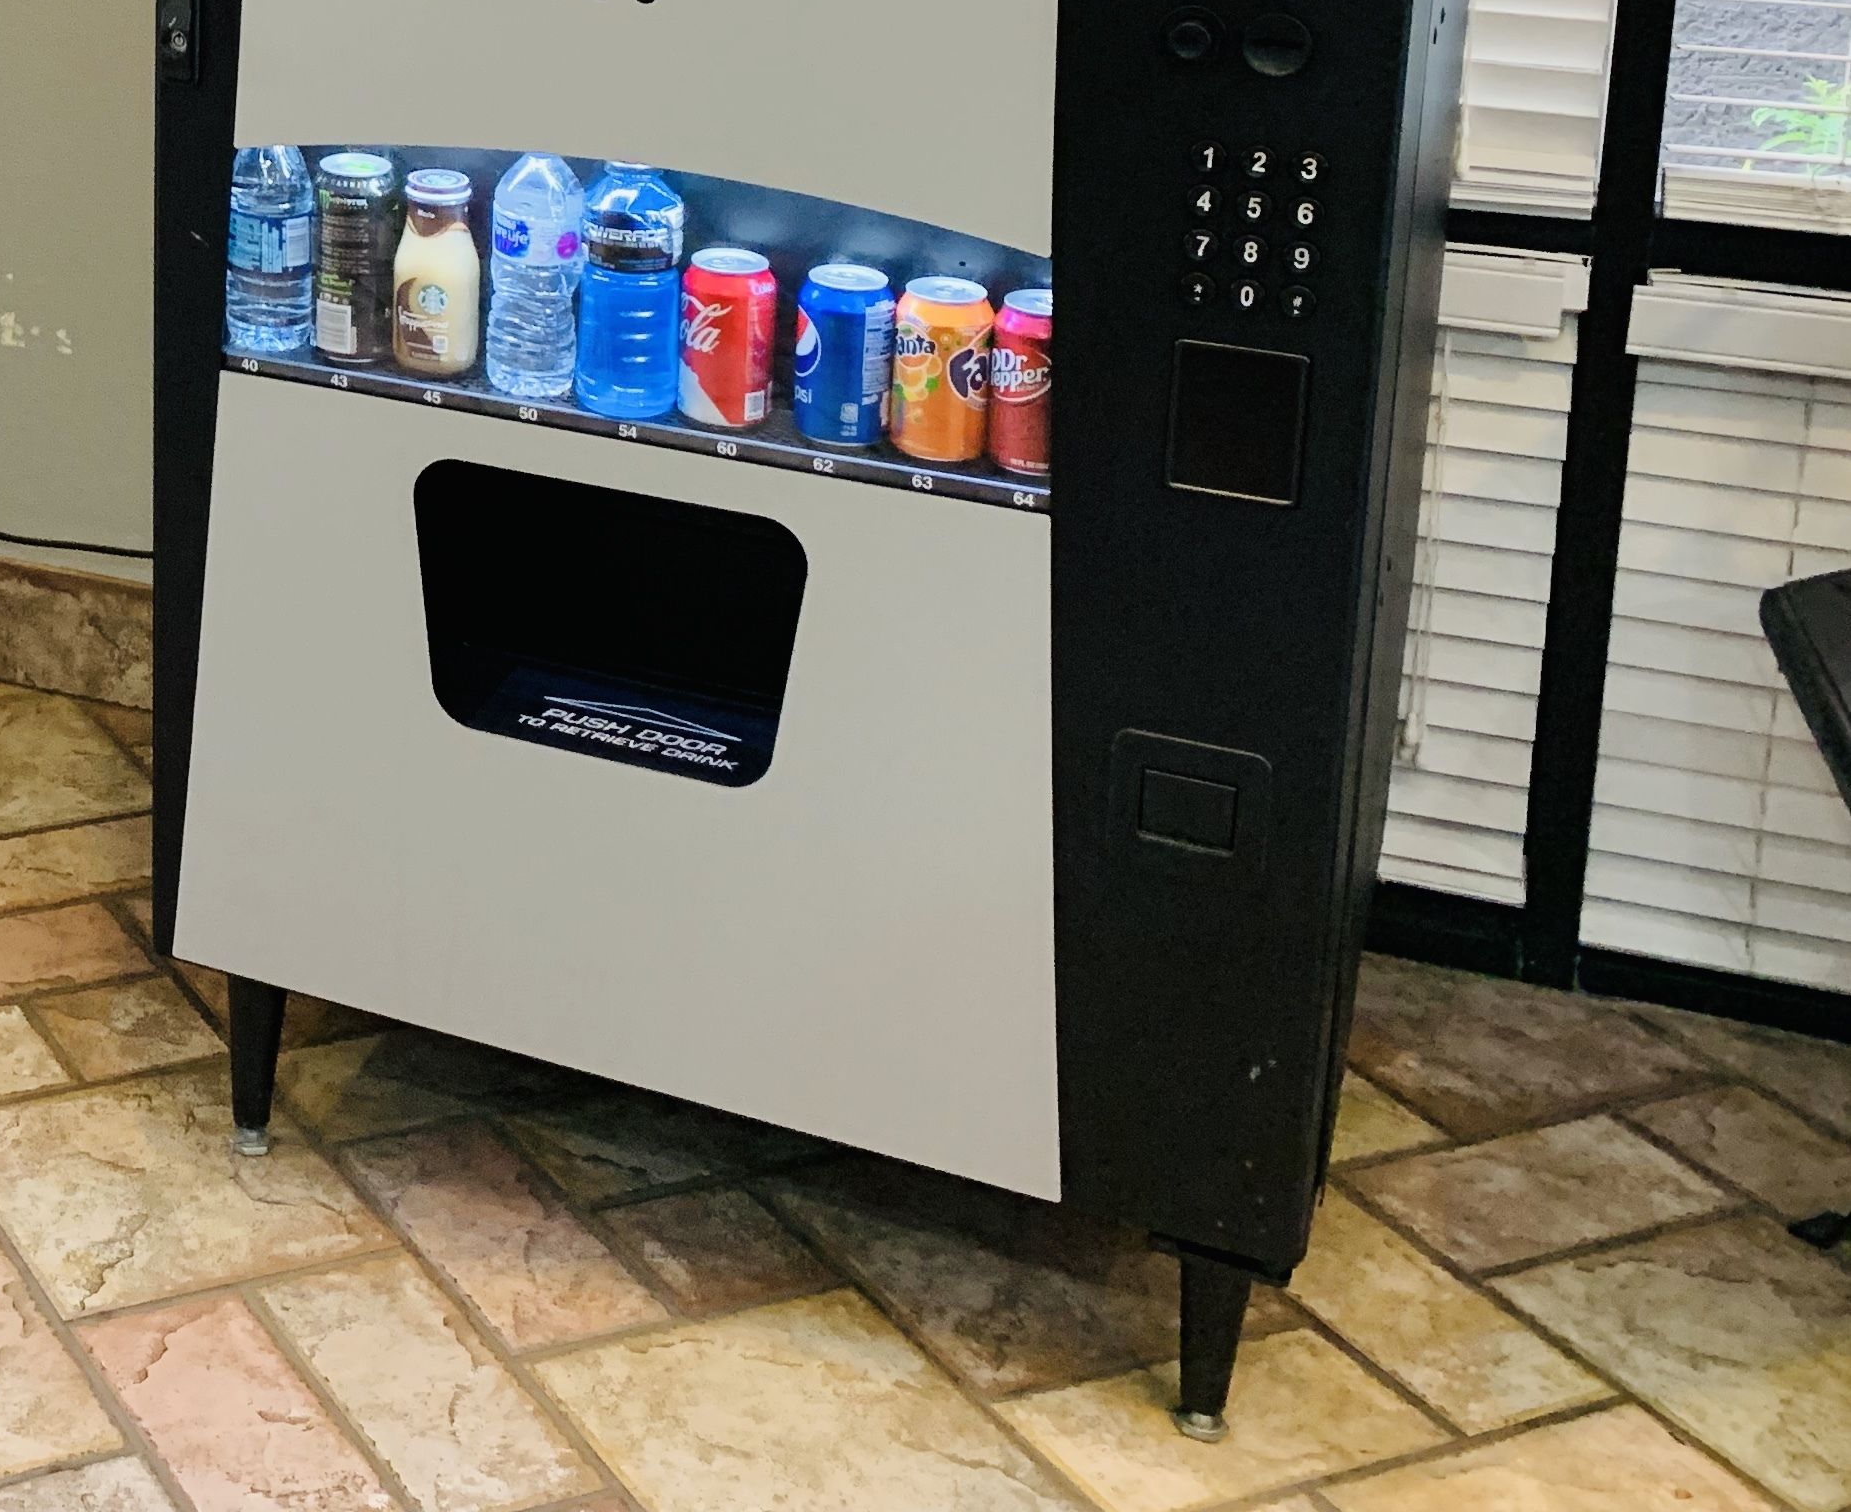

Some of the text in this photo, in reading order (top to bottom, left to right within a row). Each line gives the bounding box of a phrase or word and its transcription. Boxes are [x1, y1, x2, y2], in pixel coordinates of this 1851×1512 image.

[1203, 147, 1317, 179] 1 2 3
[1197, 191, 1314, 224] 4 5 6
[1196, 236, 1310, 269] 7 8 9
[1240, 286, 1254, 307] 0
[896, 333, 936, 356] anta
[241, 359, 259, 372] 40
[1000, 348, 1028, 372] Dr
[330, 374, 348, 387] 43
[423, 390, 442, 404] 45
[794, 384, 813, 404] psi
[519, 407, 538, 421] 50
[618, 425, 637, 439] 54
[717, 442, 737, 455] 60
[813, 458, 833, 473] 62
[912, 475, 933, 490] 63
[1013, 492, 1035, 507] 64
[542, 708, 727, 756] PUSH DOOR
[517, 714, 739, 771] TO RETRIEVE DRINK
